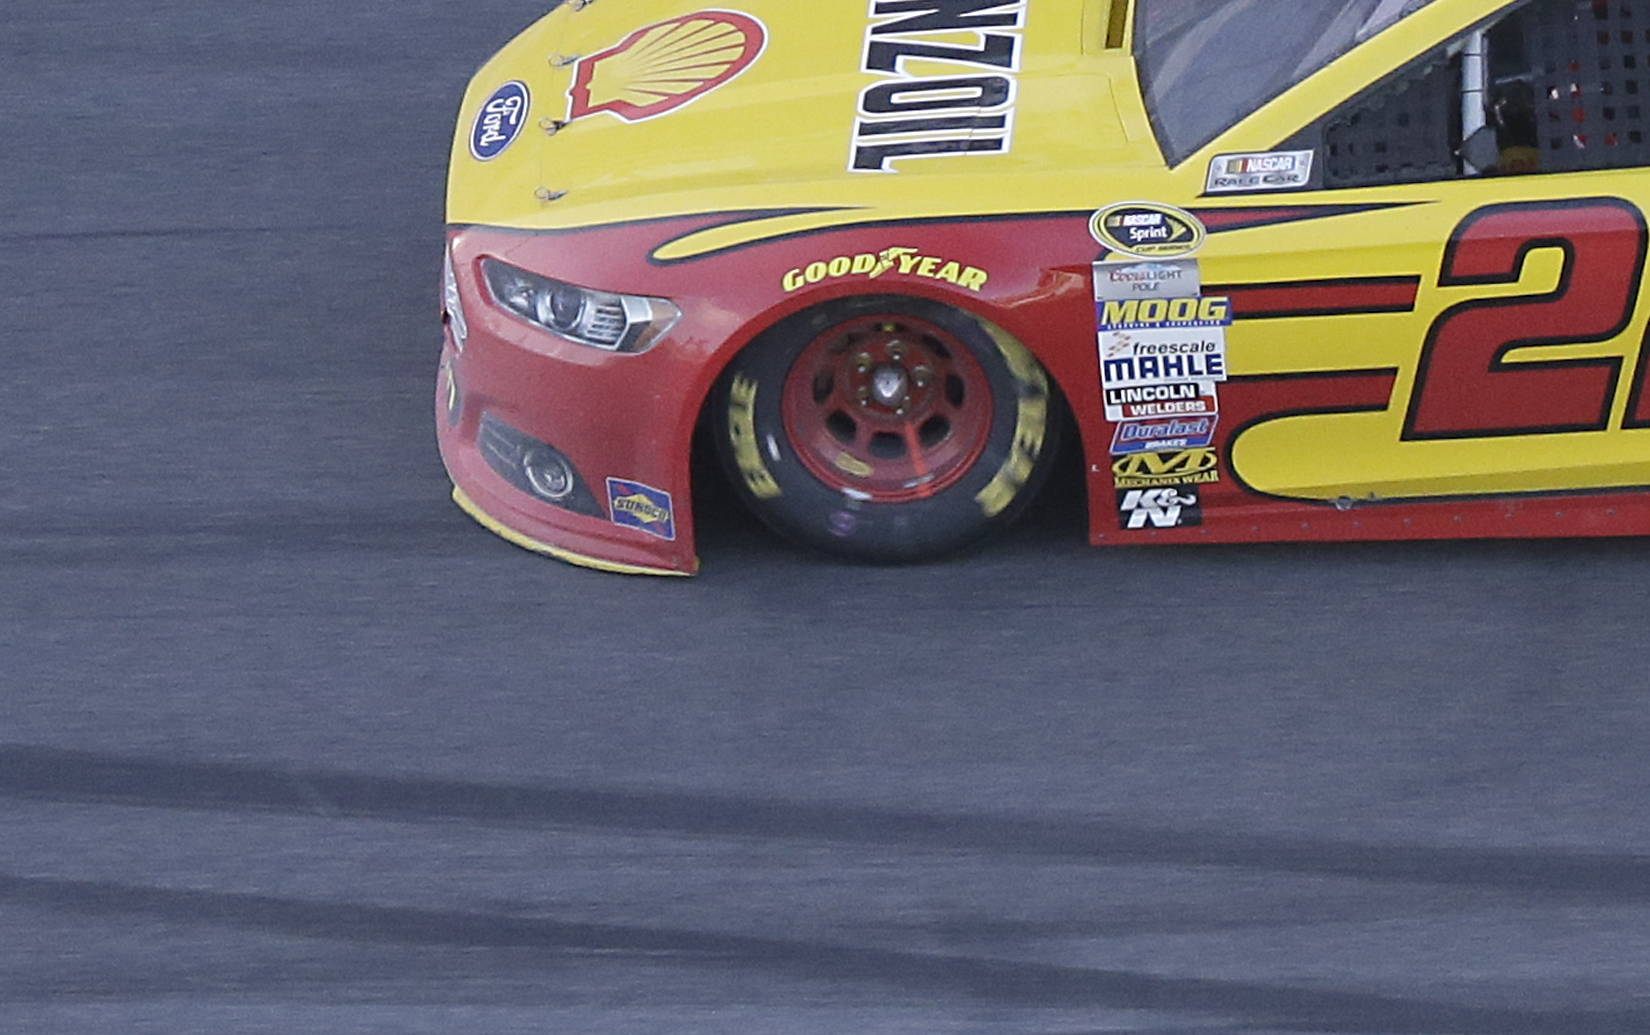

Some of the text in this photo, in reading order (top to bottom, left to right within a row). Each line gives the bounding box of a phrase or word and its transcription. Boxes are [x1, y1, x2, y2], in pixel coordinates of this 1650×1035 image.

[479, 95, 522, 147] Ford
[1246, 157, 1294, 173] NASCAR
[1129, 225, 1168, 242] Sprint
[782, 247, 989, 293] GOODYEAR
[1101, 296, 1228, 326] MOOG
[1133, 340, 1216, 356] freescale
[1104, 354, 1224, 382] MAHLE
[1110, 384, 1196, 405] LINCOLN
[1130, 400, 1207, 416] WELDERS
[1121, 417, 1210, 441] Duralast
[1181, 470, 1220, 484] WEAR
[614, 497, 670, 524] SUNOCO
